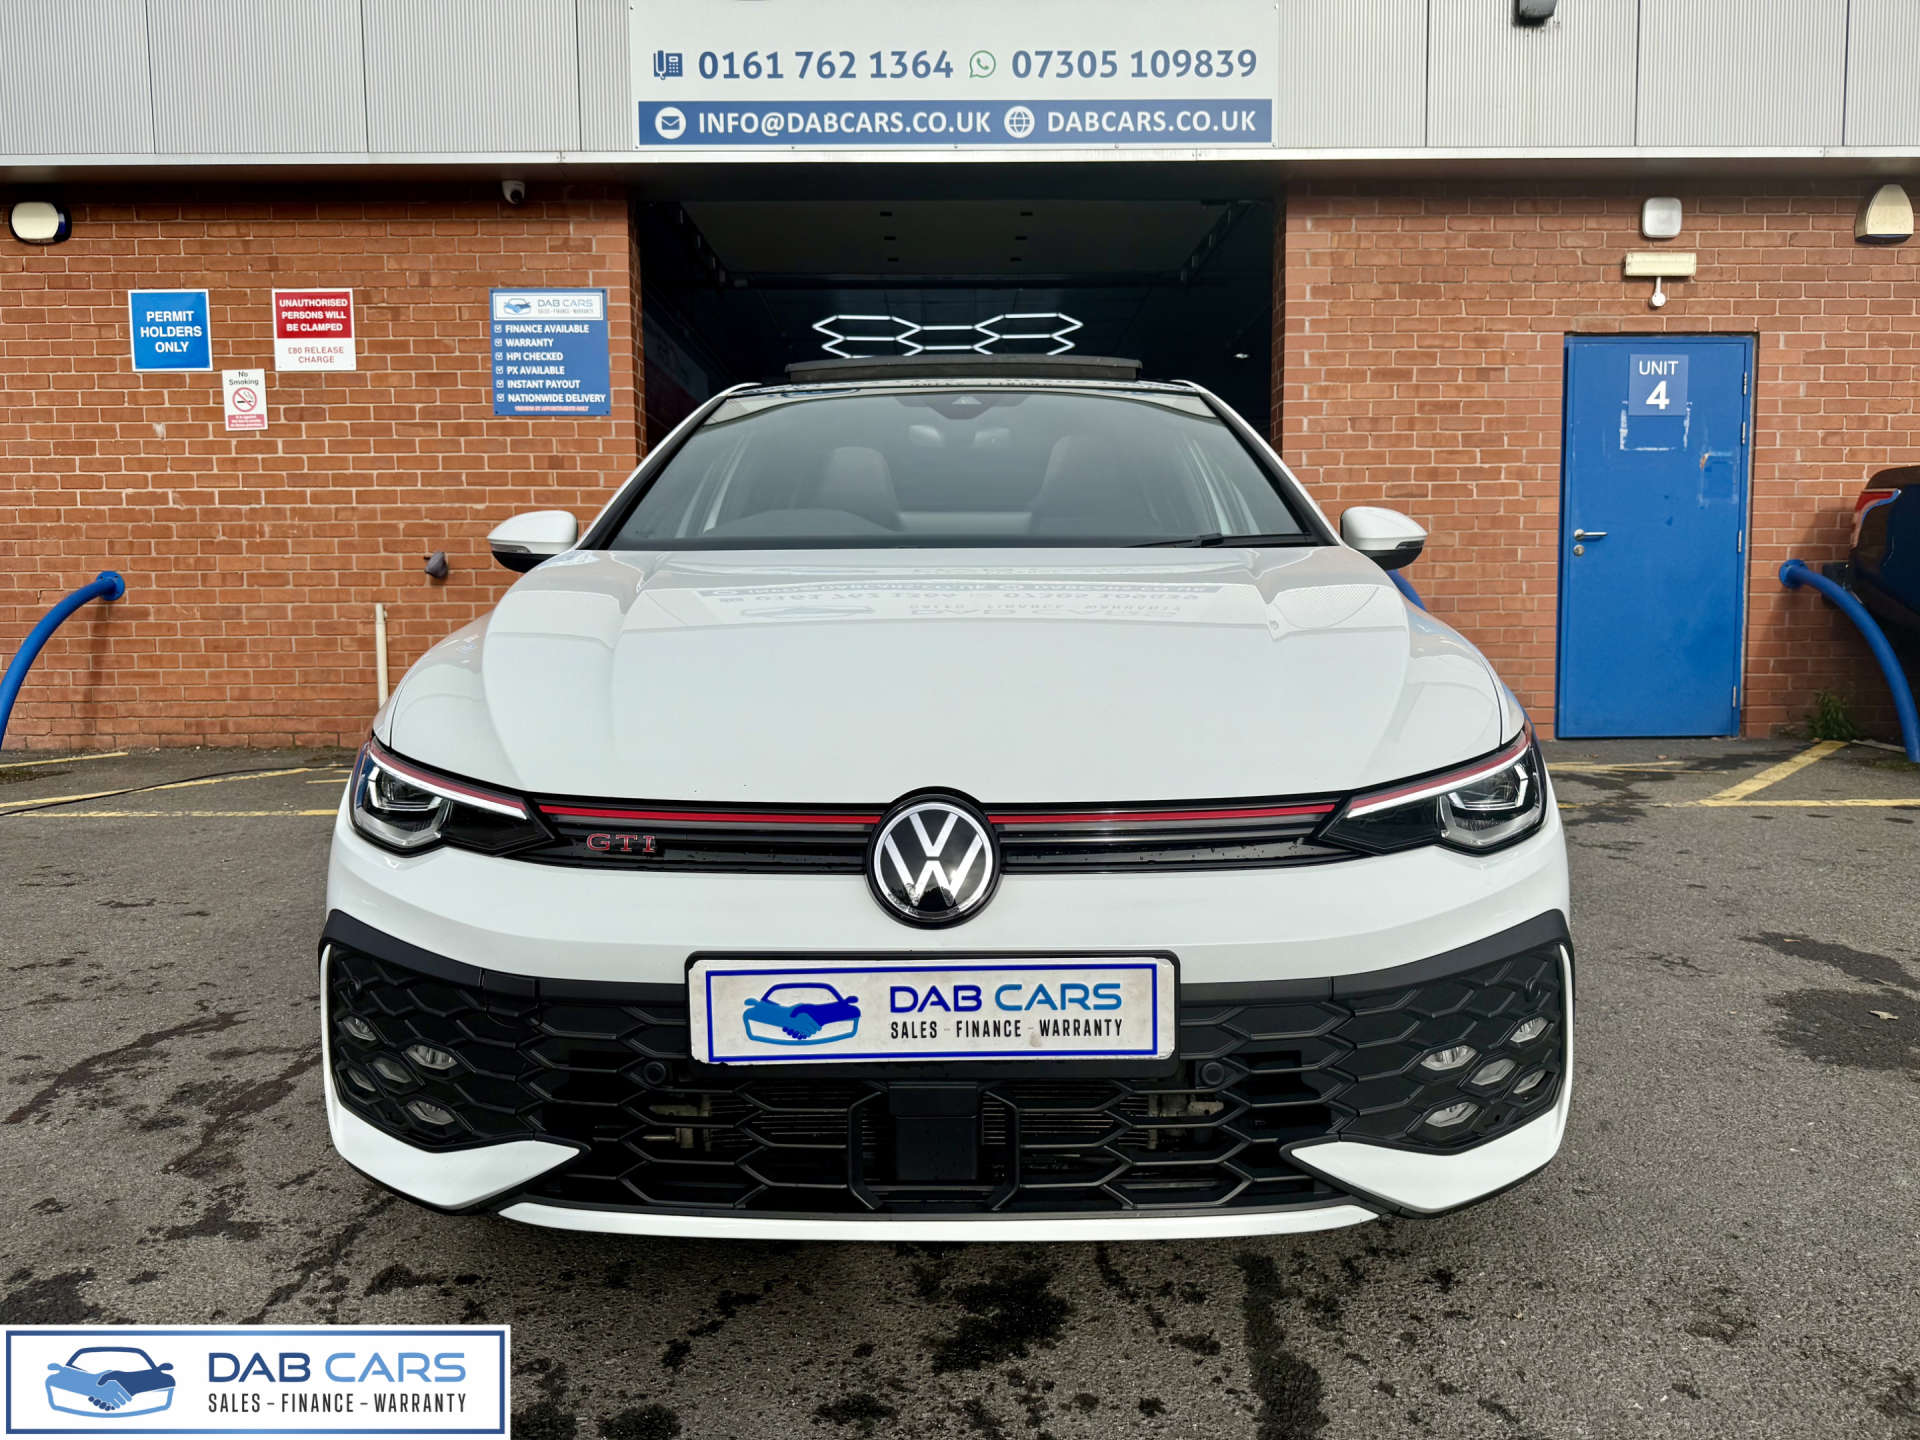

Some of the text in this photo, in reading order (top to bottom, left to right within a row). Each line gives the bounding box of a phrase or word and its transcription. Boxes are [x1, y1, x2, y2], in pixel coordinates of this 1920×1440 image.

[699, 50, 1256, 79] 0161 762 1364 07305 109839
[700, 111, 1255, 136] INFO@DABCARS.CO.UK DABCARS.CO.UK
[279, 299, 348, 307] UNAUTHORISED
[147, 311, 194, 322] PERMIT
[282, 311, 323, 319] PERSONS
[140, 326, 202, 337] HOLDERS
[300, 323, 343, 331] CLAMPED
[505, 325, 589, 333] FINANCE AVAILABLE
[155, 342, 189, 352] ONLY
[506, 338, 554, 346] WARRANTY
[507, 352, 563, 360] HPI CHECKED
[507, 366, 564, 374] PX AVAILABLE
[1639, 361, 1678, 375] UNIT
[508, 380, 580, 388] INSTANT PAYOUT
[508, 394, 606, 402] NATIONWIDE DELIVERY
[1646, 381, 1669, 409] 4
[586, 833, 656, 853] GTI
[890, 983, 1121, 1013] DAB CARS
[891, 1021, 937, 1039] SALES
[957, 1020, 1021, 1037] FINANCE
[1040, 1019, 1122, 1036] WARRANTY
